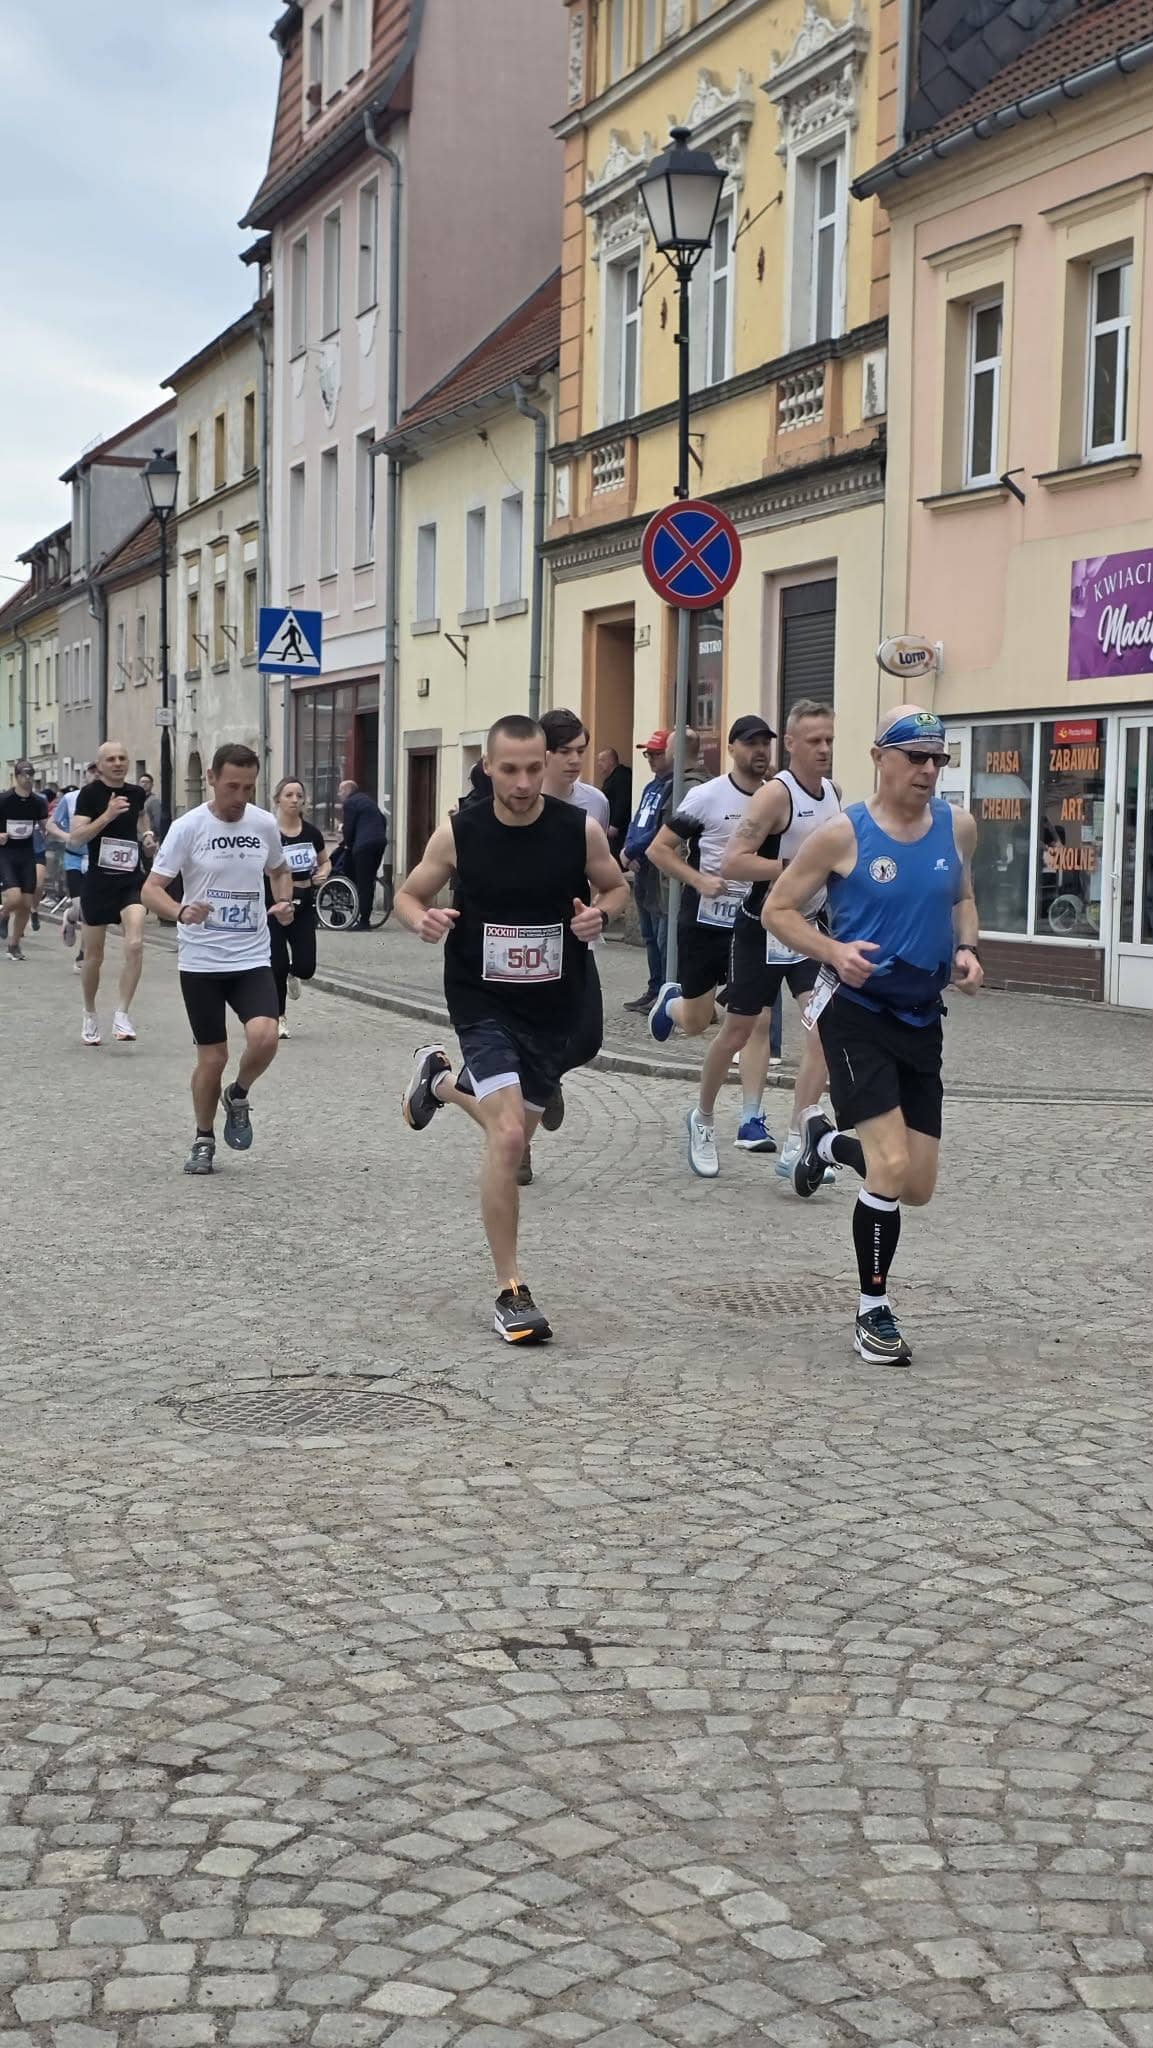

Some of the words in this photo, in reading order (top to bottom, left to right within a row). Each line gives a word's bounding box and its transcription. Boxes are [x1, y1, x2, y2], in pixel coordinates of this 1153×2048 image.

[986, 750, 1019, 773] PRASA
[1049, 748, 1100, 772] ZABAWKI
[981, 798, 1021, 821] CHEMIA
[1061, 798, 1085, 821] ART.
[112, 850, 129, 863] 30
[1047, 847, 1096, 872] SZKOLNE
[220, 906, 247, 923] 121
[487, 927, 516, 937] XXXIII
[507, 947, 541, 969] 50
